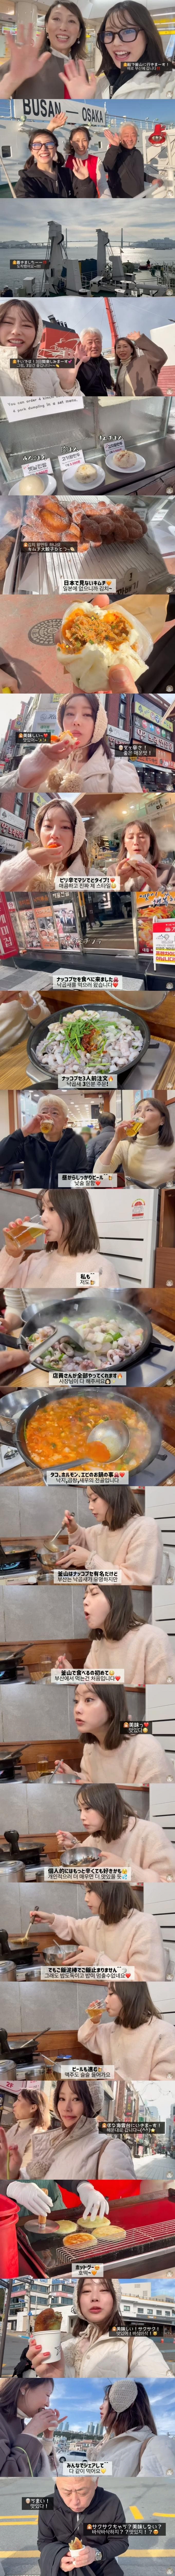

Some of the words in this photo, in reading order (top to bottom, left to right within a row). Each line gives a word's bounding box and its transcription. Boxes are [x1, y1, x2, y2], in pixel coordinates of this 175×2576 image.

[23, 99, 61, 117] BUSAN
[82, 107, 103, 123] OSAKA
[62, 453, 80, 461] 고기왕만두
[28, 462, 47, 471] 옛날찐빵
[148, 734, 173, 750] 노래연습장
[97, 892, 111, 909] 집
